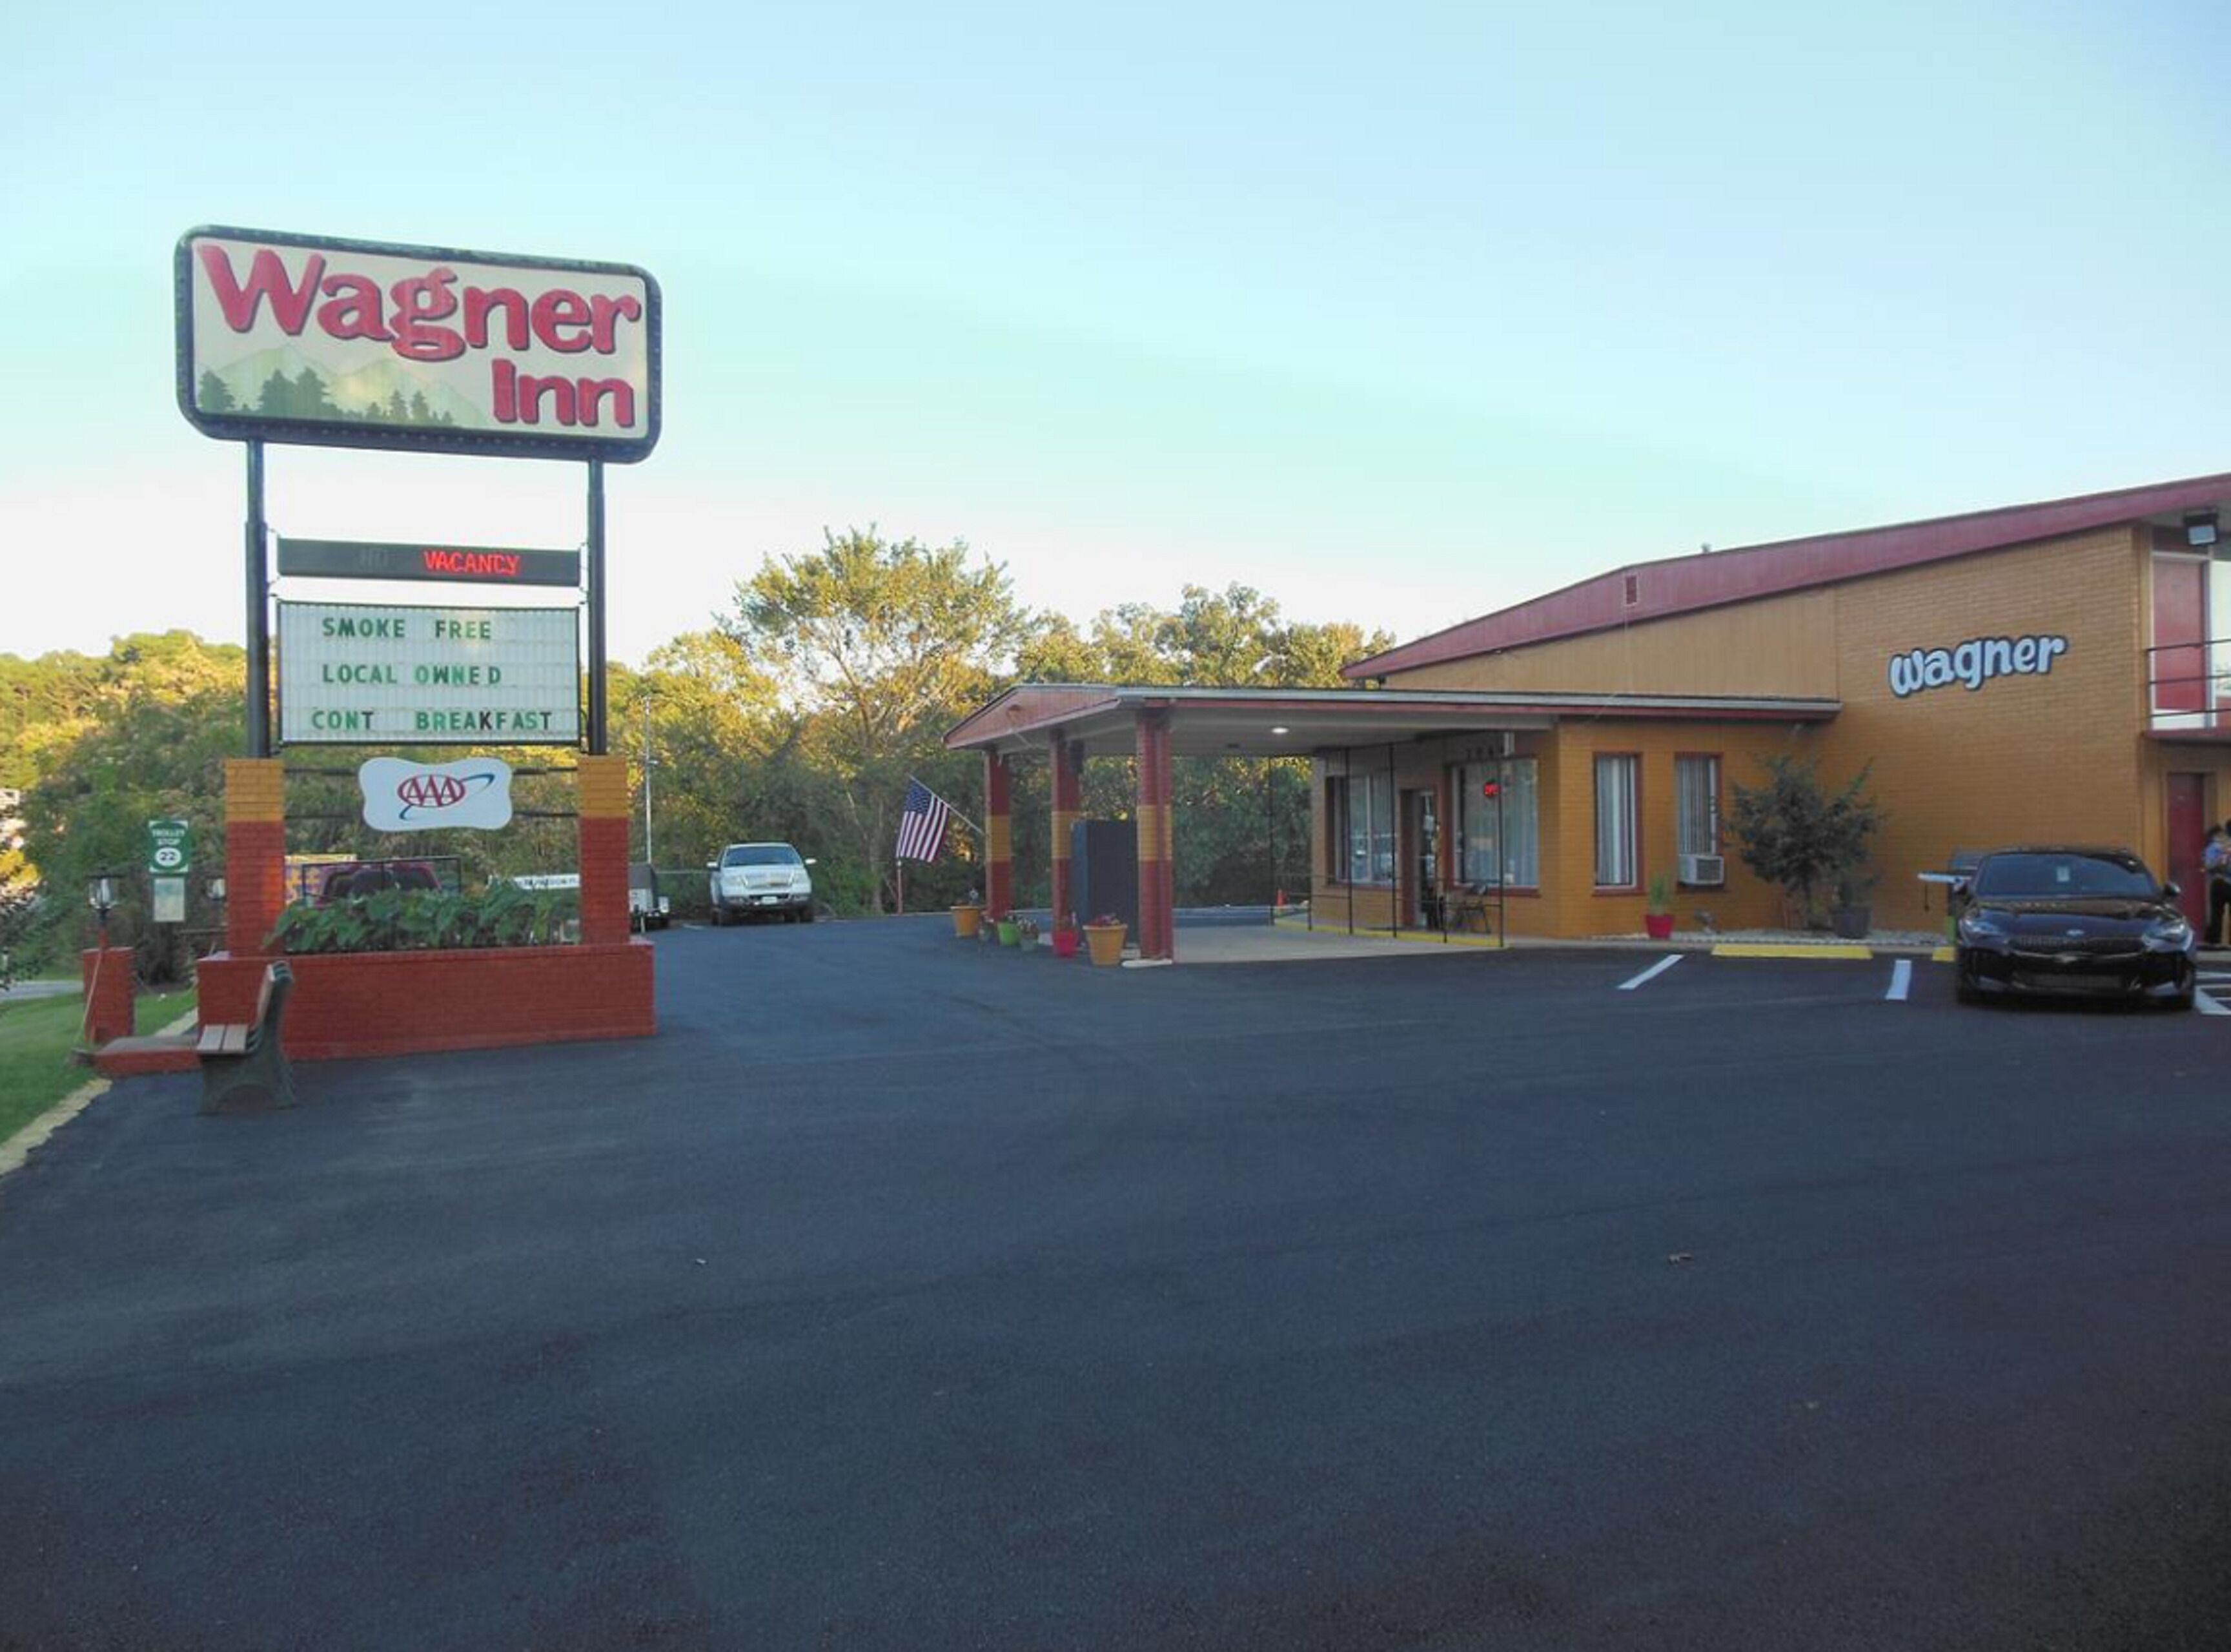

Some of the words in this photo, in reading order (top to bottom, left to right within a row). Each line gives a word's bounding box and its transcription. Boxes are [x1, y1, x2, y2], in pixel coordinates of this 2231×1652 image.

[198, 245, 642, 362] Wagner
[492, 359, 635, 427] Inn
[423, 551, 520, 575] VACANCY
[323, 618, 405, 638] SMOKE
[435, 620, 491, 639] FREE
[323, 664, 397, 684] LOCAL
[415, 666, 502, 684] OWNED
[312, 711, 374, 730] CONT
[416, 711, 552, 731] BREAKFAST
[398, 774, 465, 808] AAA
[159, 851, 176, 861] 22
